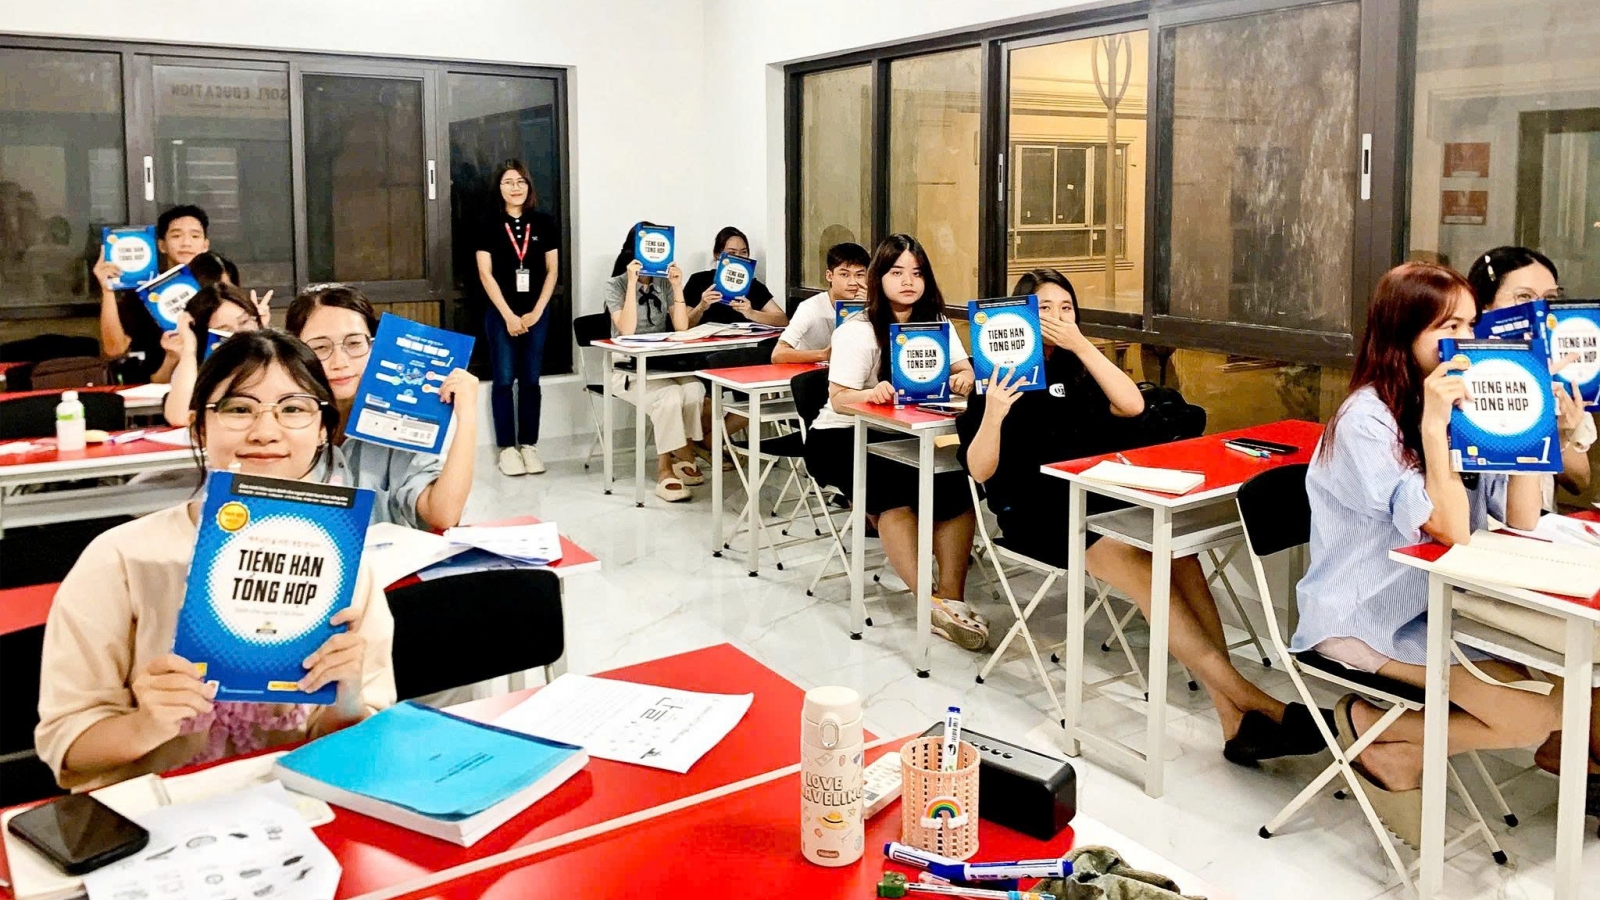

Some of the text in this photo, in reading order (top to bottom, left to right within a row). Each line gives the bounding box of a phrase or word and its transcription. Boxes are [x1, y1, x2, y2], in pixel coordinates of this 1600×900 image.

[1031, 365, 1040, 385] 1
[939, 382, 947, 398] 1
[1541, 437, 1551, 464] 1
[805, 771, 844, 791] LOVE
